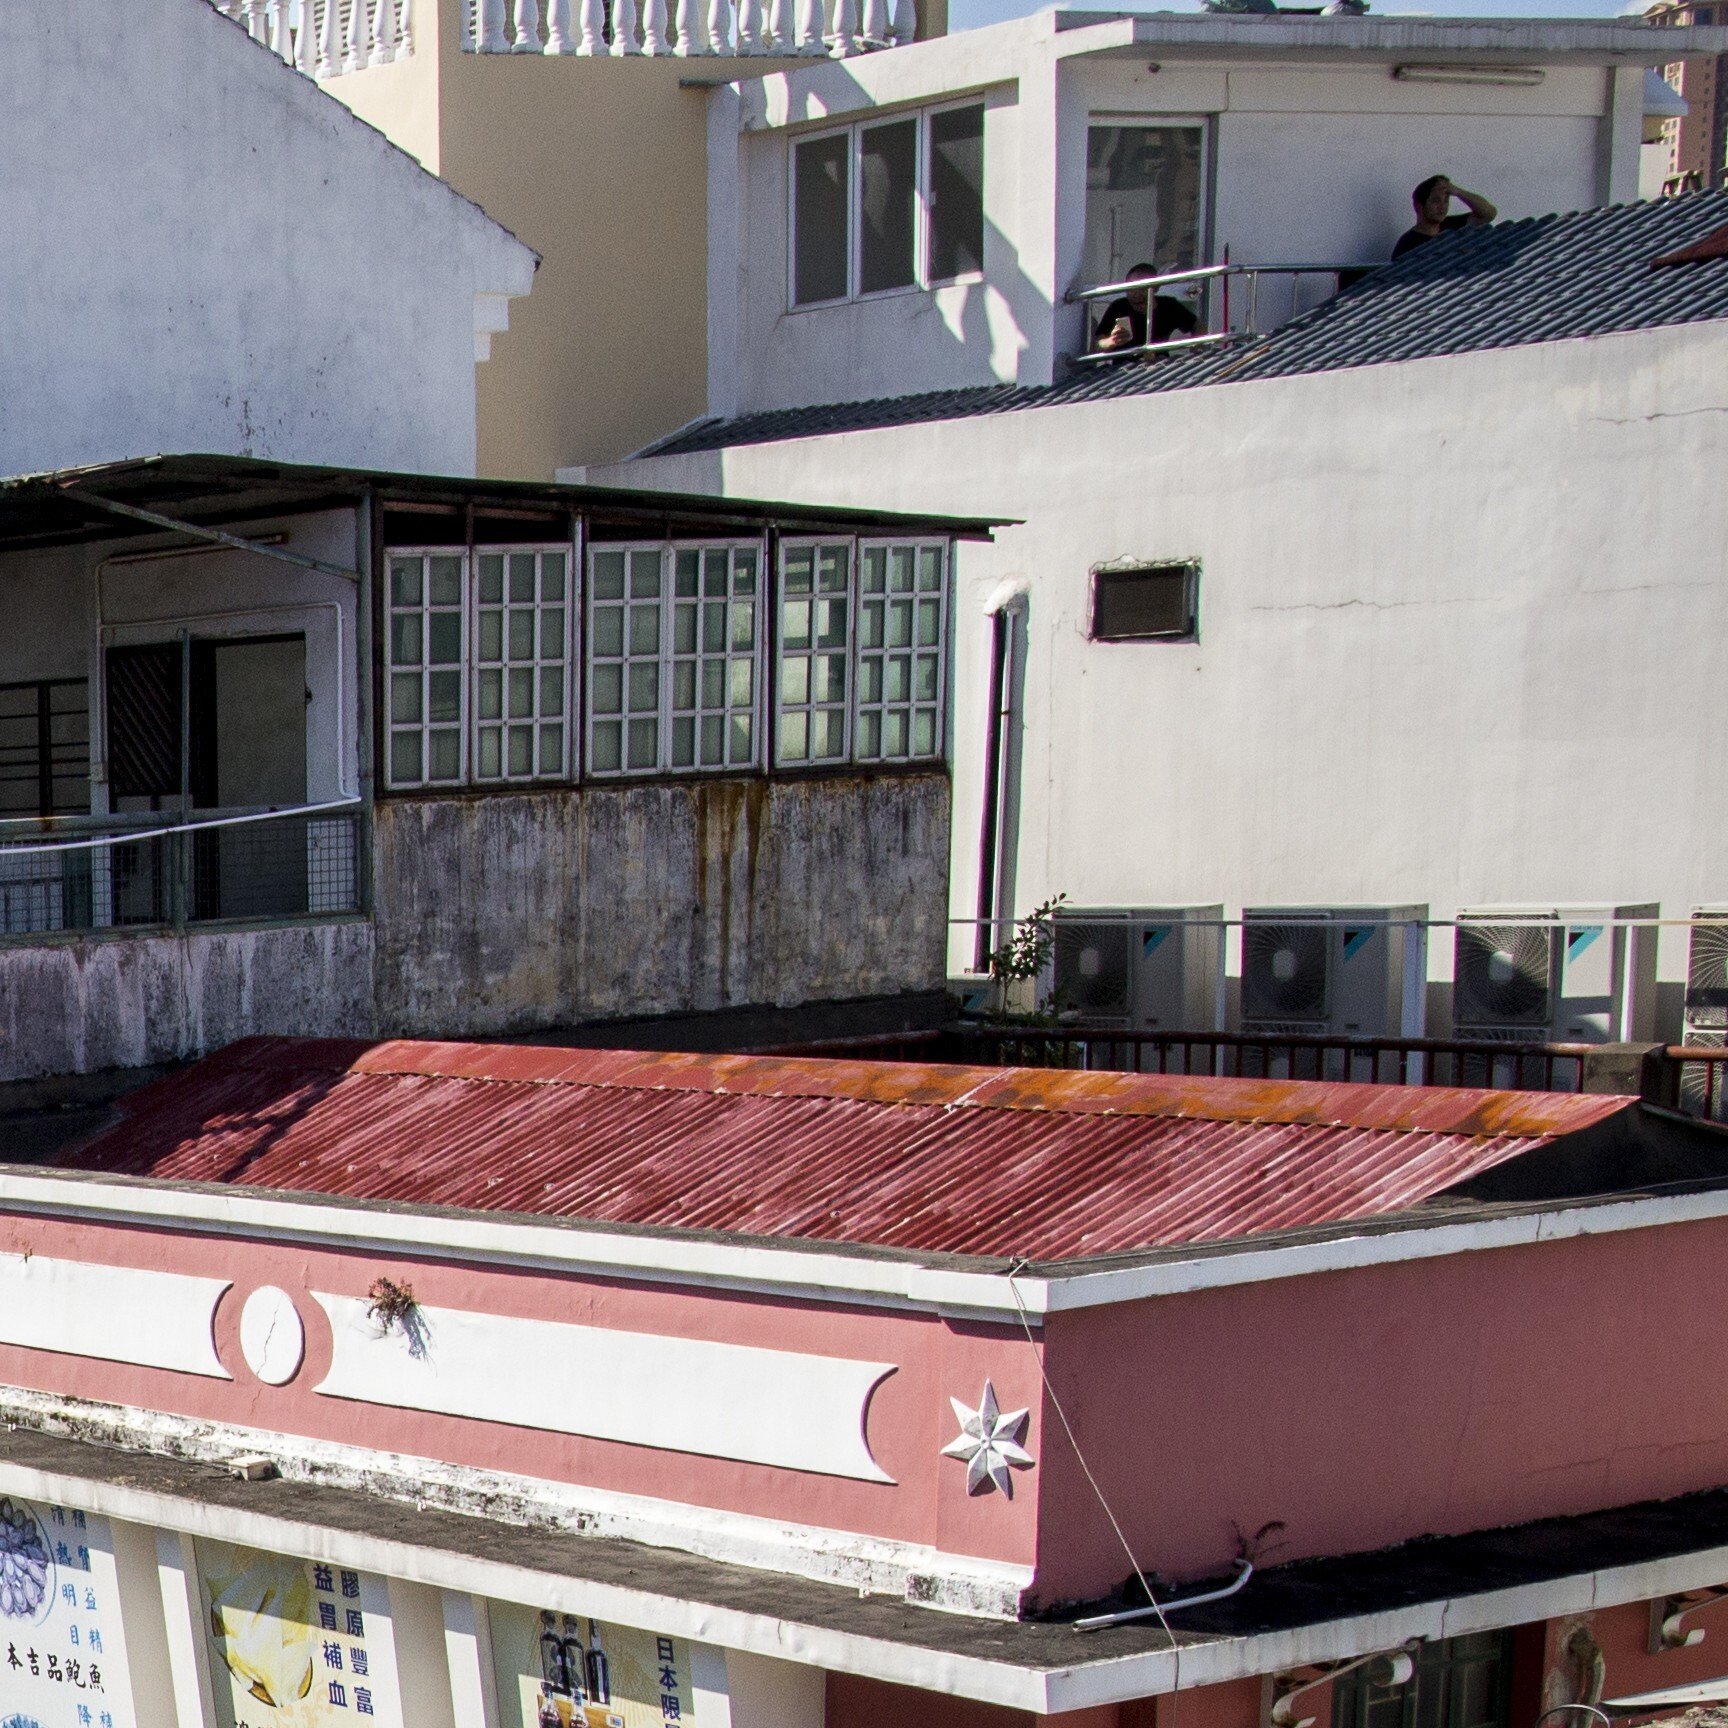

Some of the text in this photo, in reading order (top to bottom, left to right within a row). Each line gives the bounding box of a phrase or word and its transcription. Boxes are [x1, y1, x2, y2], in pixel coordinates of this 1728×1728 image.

[312, 1562, 349, 1709] 益胃補血
[340, 1568, 376, 1717] 膠原豐富
